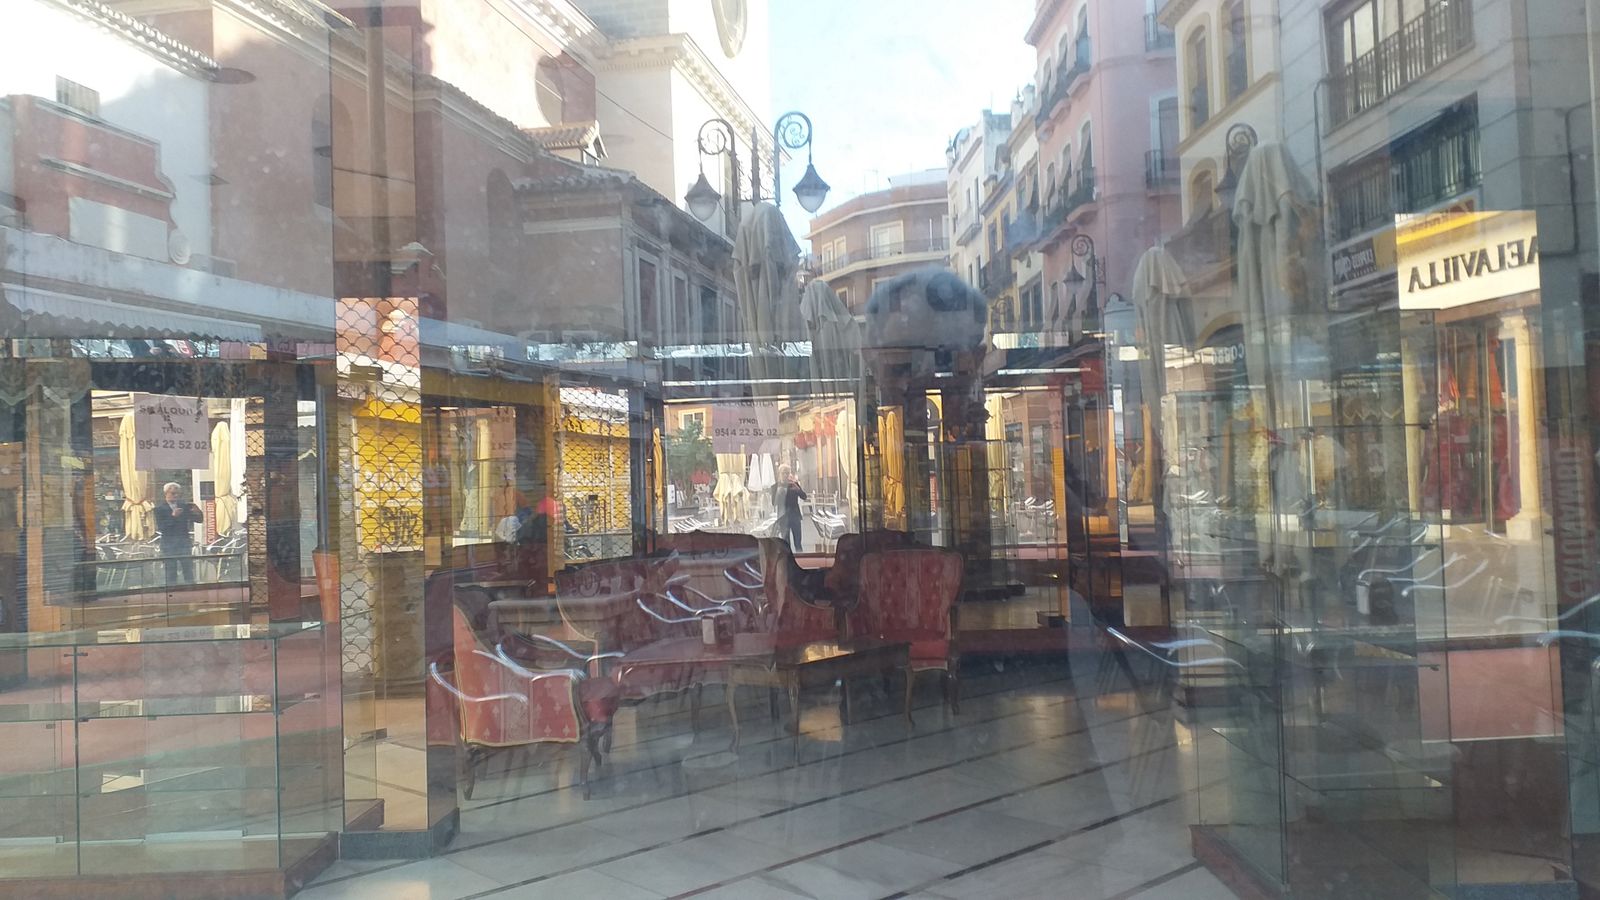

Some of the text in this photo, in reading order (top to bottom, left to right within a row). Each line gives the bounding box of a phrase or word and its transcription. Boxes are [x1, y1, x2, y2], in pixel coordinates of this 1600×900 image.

[739, 428, 750, 436] 22
[138, 439, 207, 450] 954 22 52 02
